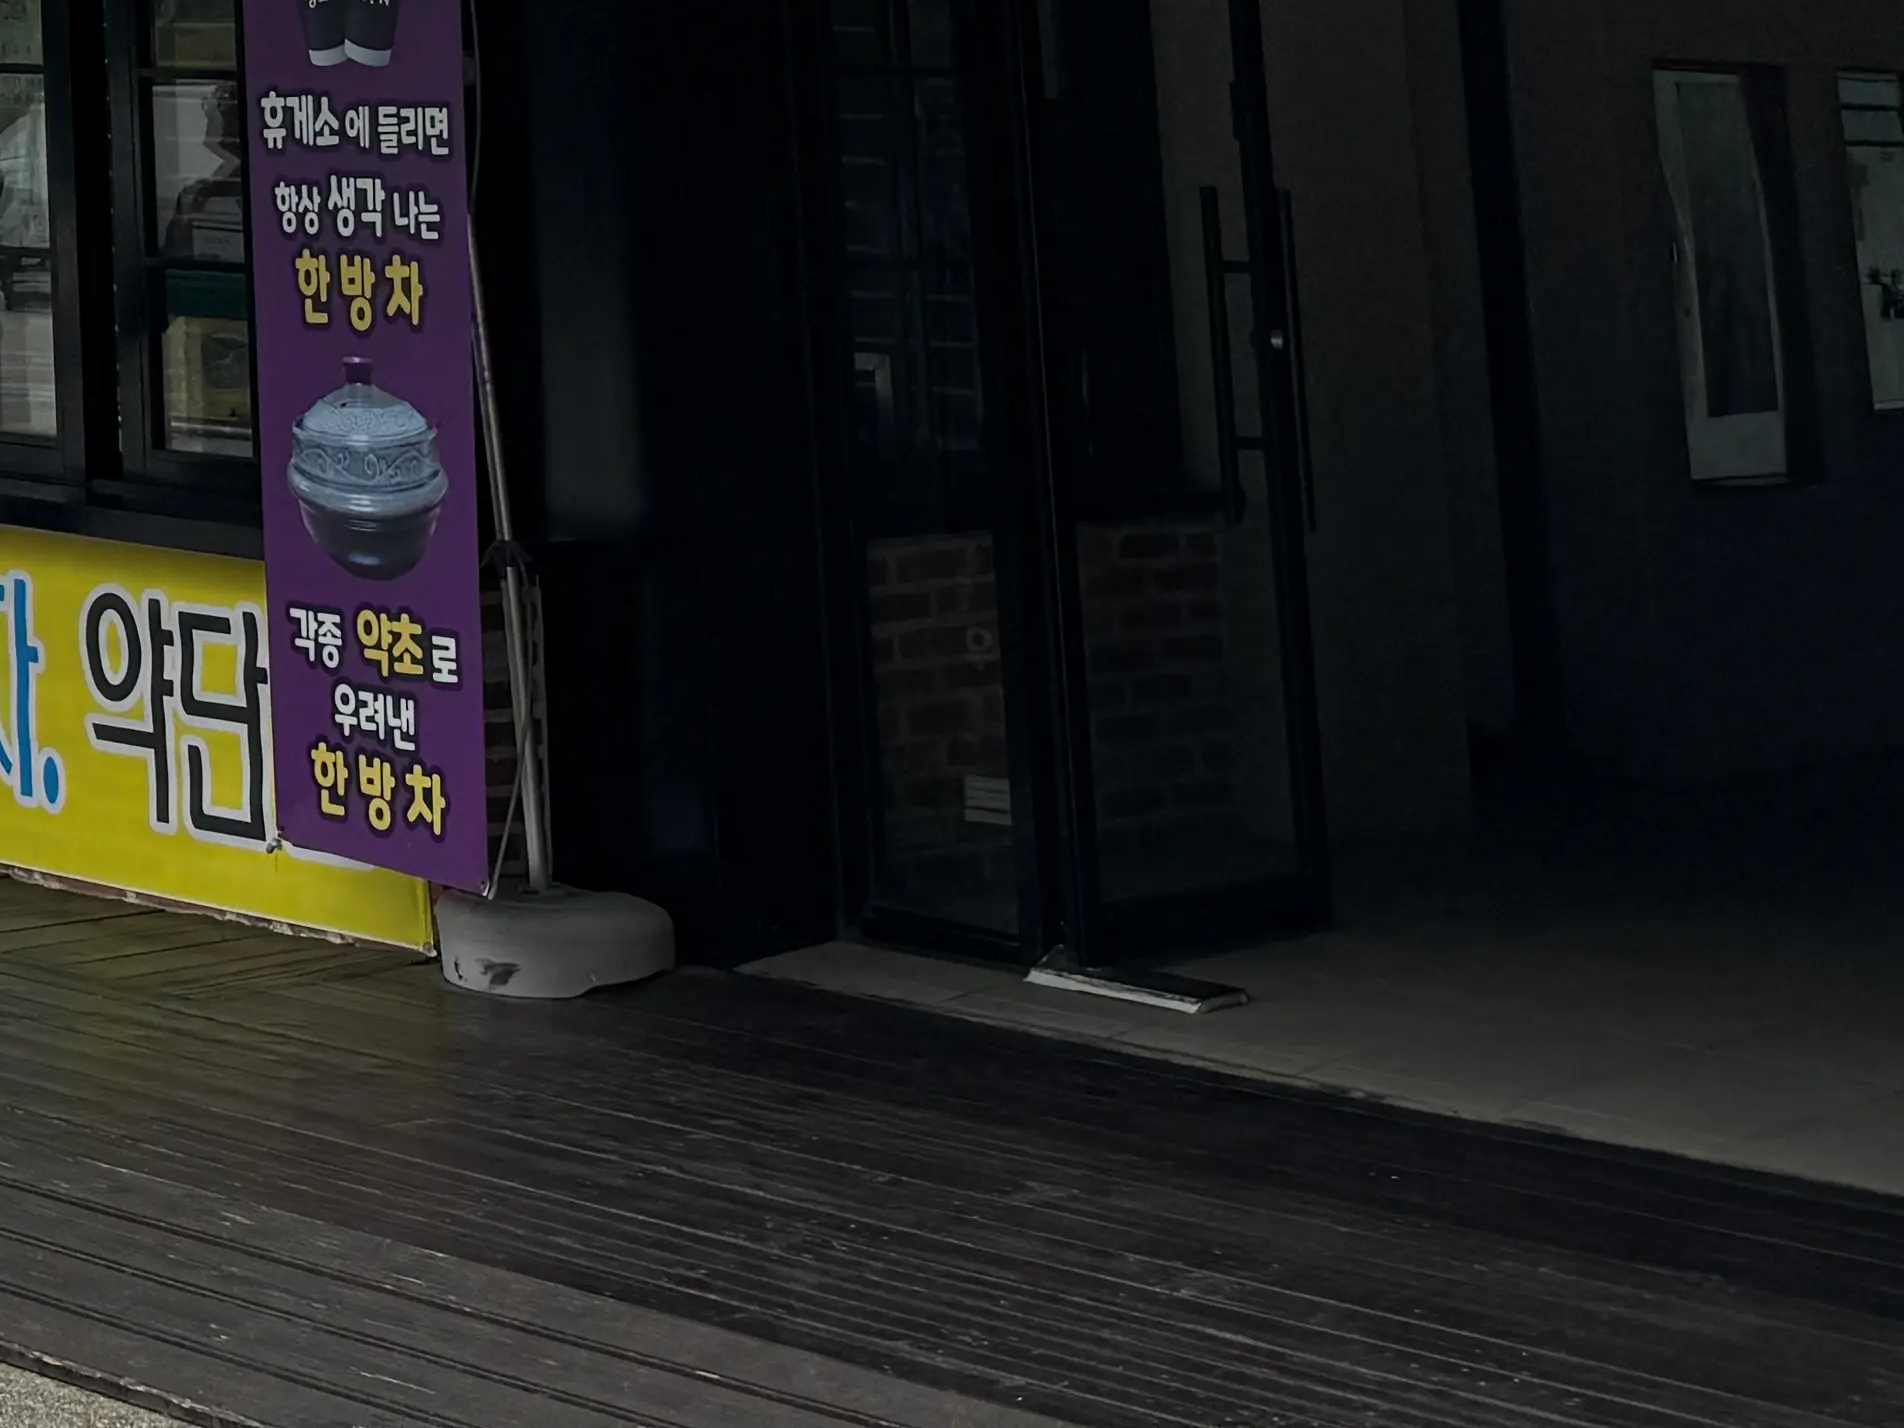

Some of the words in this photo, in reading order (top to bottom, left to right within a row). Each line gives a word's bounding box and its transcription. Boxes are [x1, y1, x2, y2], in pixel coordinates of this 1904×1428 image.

[376, 105, 450, 157] 들리면
[274, 181, 322, 235] 항상
[289, 606, 343, 669] 각종
[334, 682, 416, 752] 우려낸
